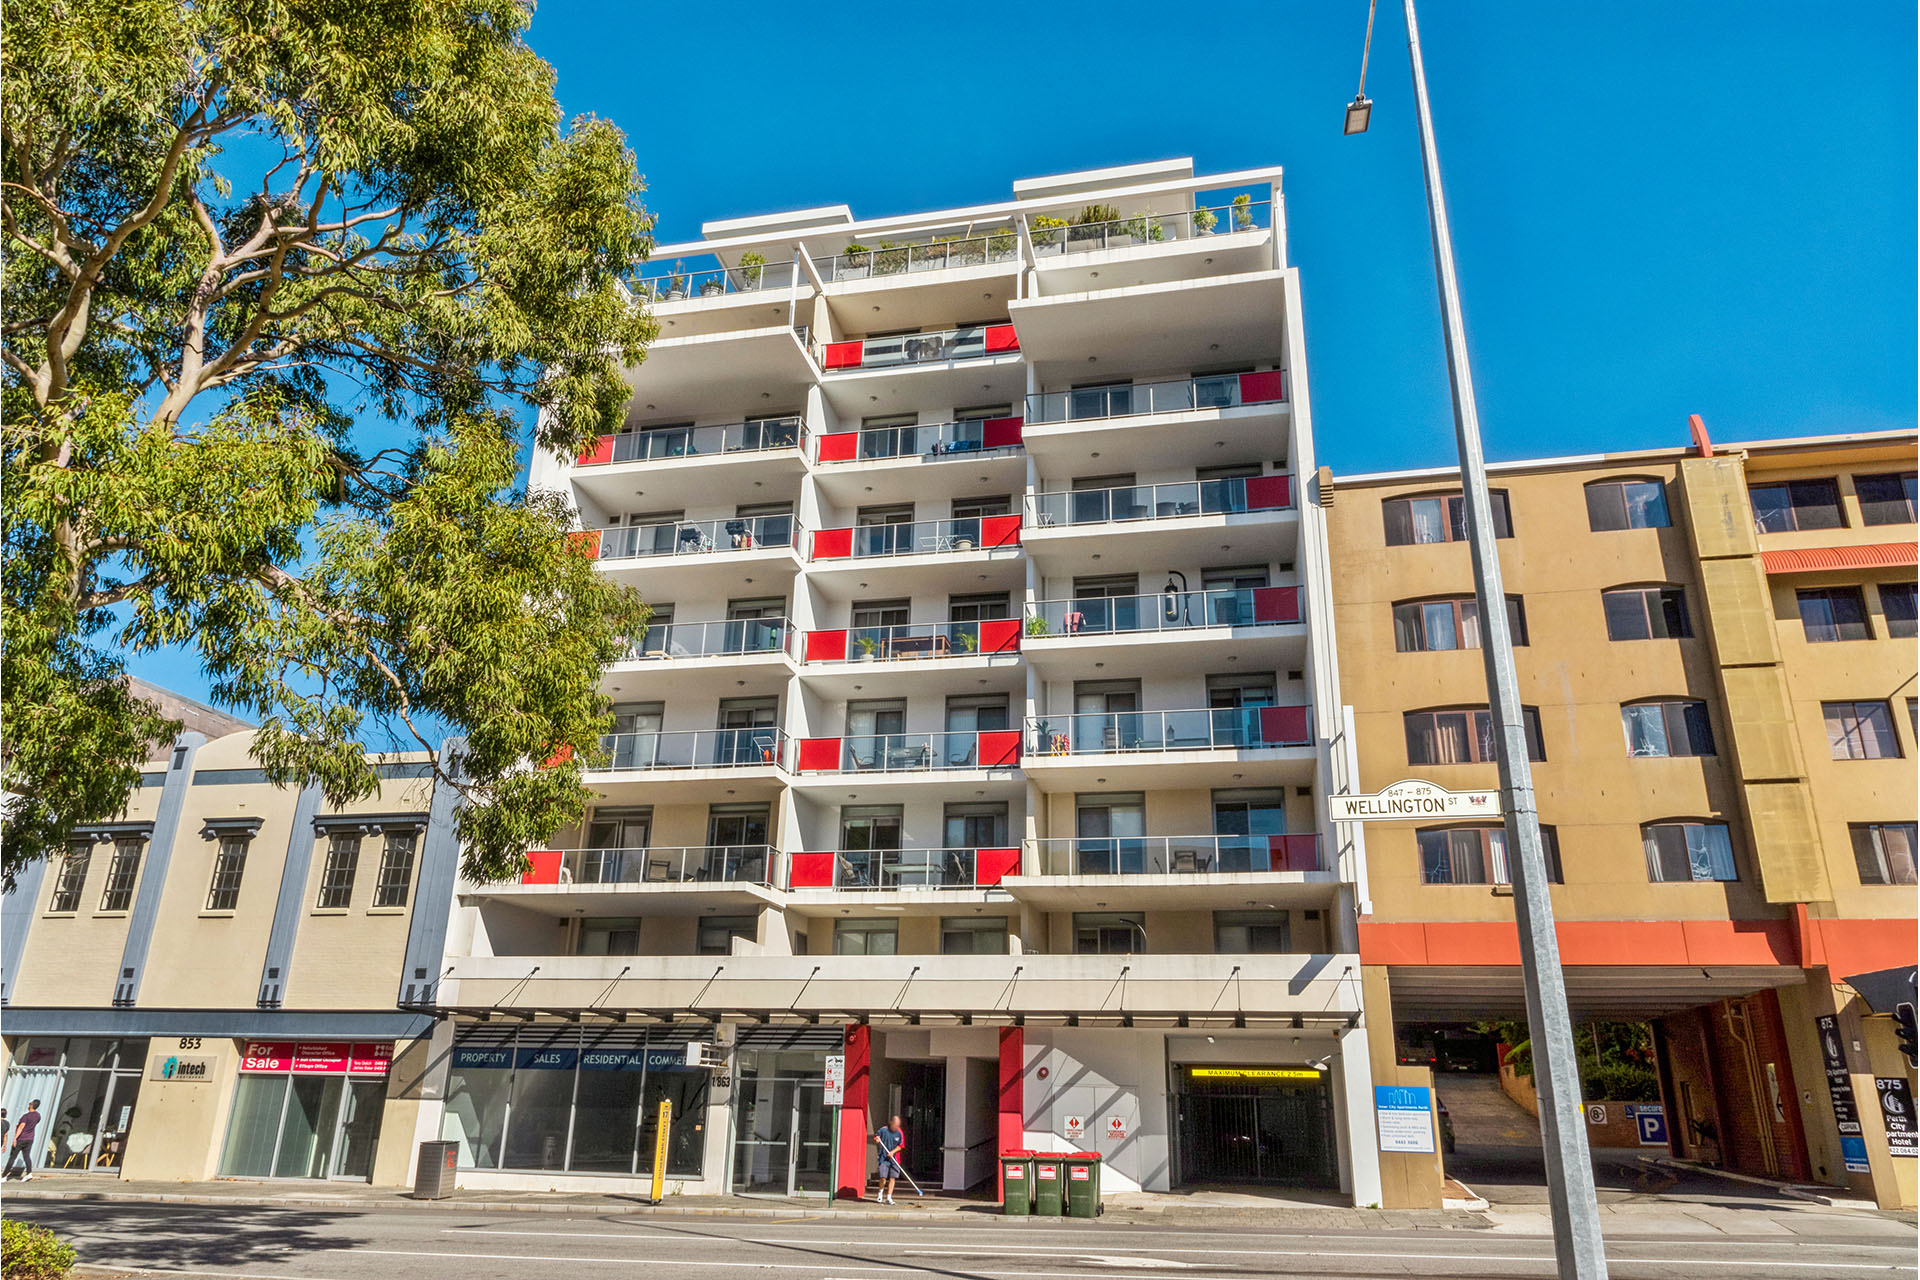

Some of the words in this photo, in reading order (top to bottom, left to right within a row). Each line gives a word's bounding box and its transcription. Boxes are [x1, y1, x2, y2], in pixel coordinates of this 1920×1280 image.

[1388, 789, 1404, 797] 847
[1415, 787, 1432, 795] 875
[1345, 798, 1445, 815] WELLINGTON
[1448, 797, 1458, 805] ST
[1821, 1017, 1833, 1029] 875
[179, 1037, 202, 1049] 853
[248, 1044, 274, 1055] For
[246, 1057, 279, 1069] Sale
[460, 1053, 506, 1063] PROPERTY
[534, 1054, 561, 1063] SALES
[583, 1054, 641, 1065] RESIDENTIAL
[177, 1061, 206, 1075] intech
[1876, 1079, 1902, 1090] 875
[1643, 1118, 1660, 1139] P
[1890, 1123, 1906, 1131] City
[1891, 1138, 1912, 1146] Hotel
